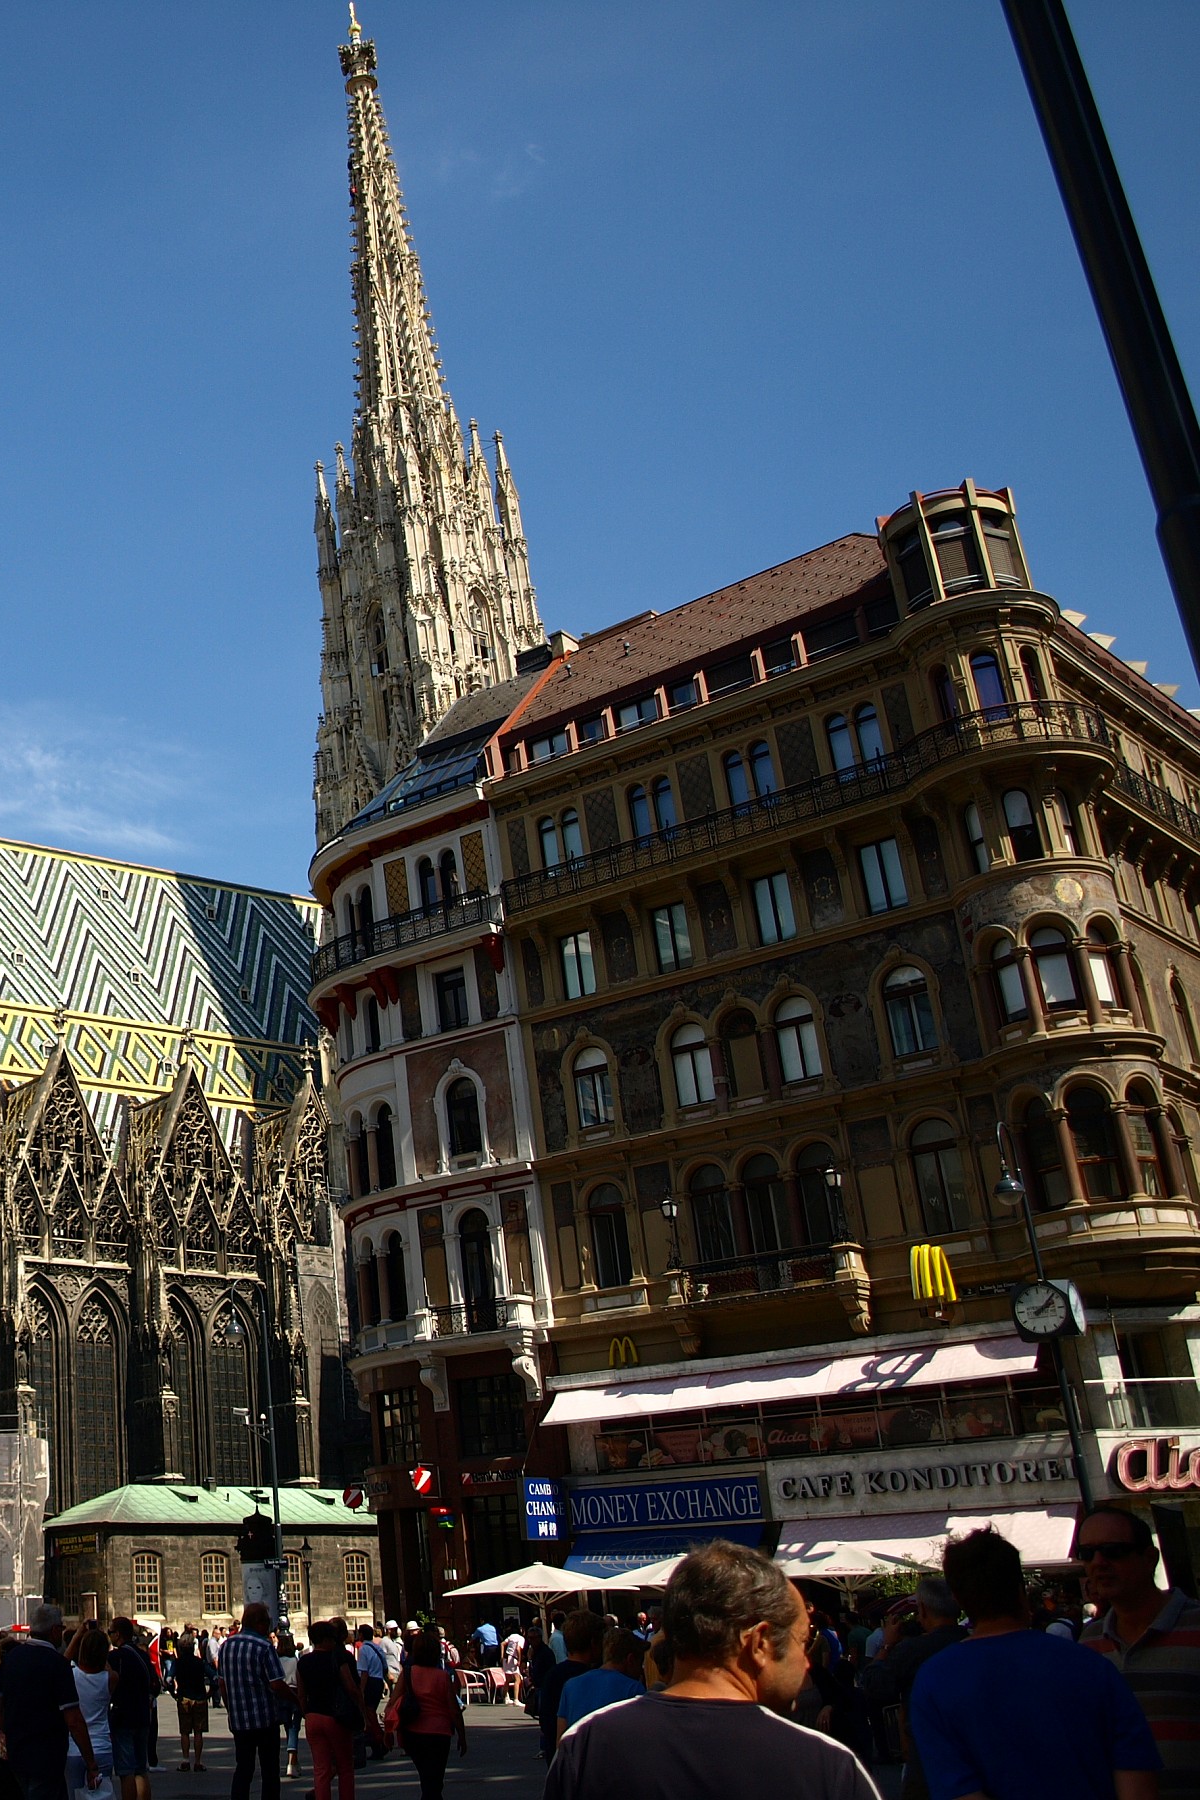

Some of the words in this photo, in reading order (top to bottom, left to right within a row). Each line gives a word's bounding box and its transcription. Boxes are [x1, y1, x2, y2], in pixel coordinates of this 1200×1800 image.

[777, 1472, 854, 1500] CAFÉ
[863, 1457, 1076, 1495] KONDITOREI
[1115, 1437, 1200, 1492] Ai
[528, 1483, 559, 1496] CAMBIO
[526, 1501, 565, 1516] CHANGE
[570, 1493, 640, 1526] MONEY
[645, 1485, 762, 1521] EXCHANGE
[584, 1550, 611, 1561] THE
